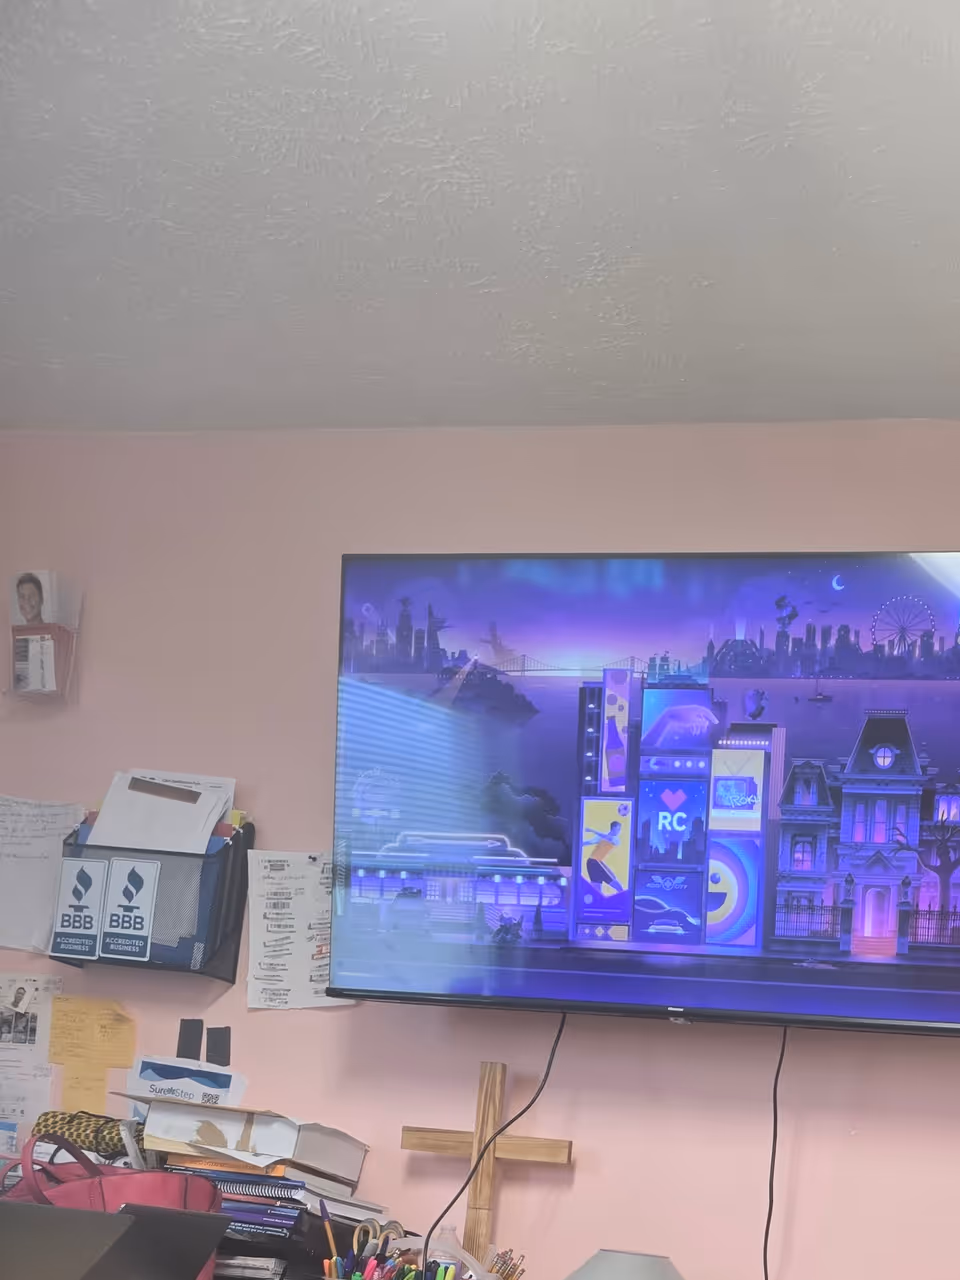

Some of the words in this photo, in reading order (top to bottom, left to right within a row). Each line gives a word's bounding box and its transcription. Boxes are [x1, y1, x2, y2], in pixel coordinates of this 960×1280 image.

[657, 811, 687, 831] RC
[60, 913, 94, 930] BBB
[108, 913, 144, 931] BBB
[56, 937, 94, 945] ACCREDITED
[105, 937, 144, 946] ACCREDITED
[60, 944, 90, 952] BUSINESS
[109, 944, 139, 953] BUSINESS
